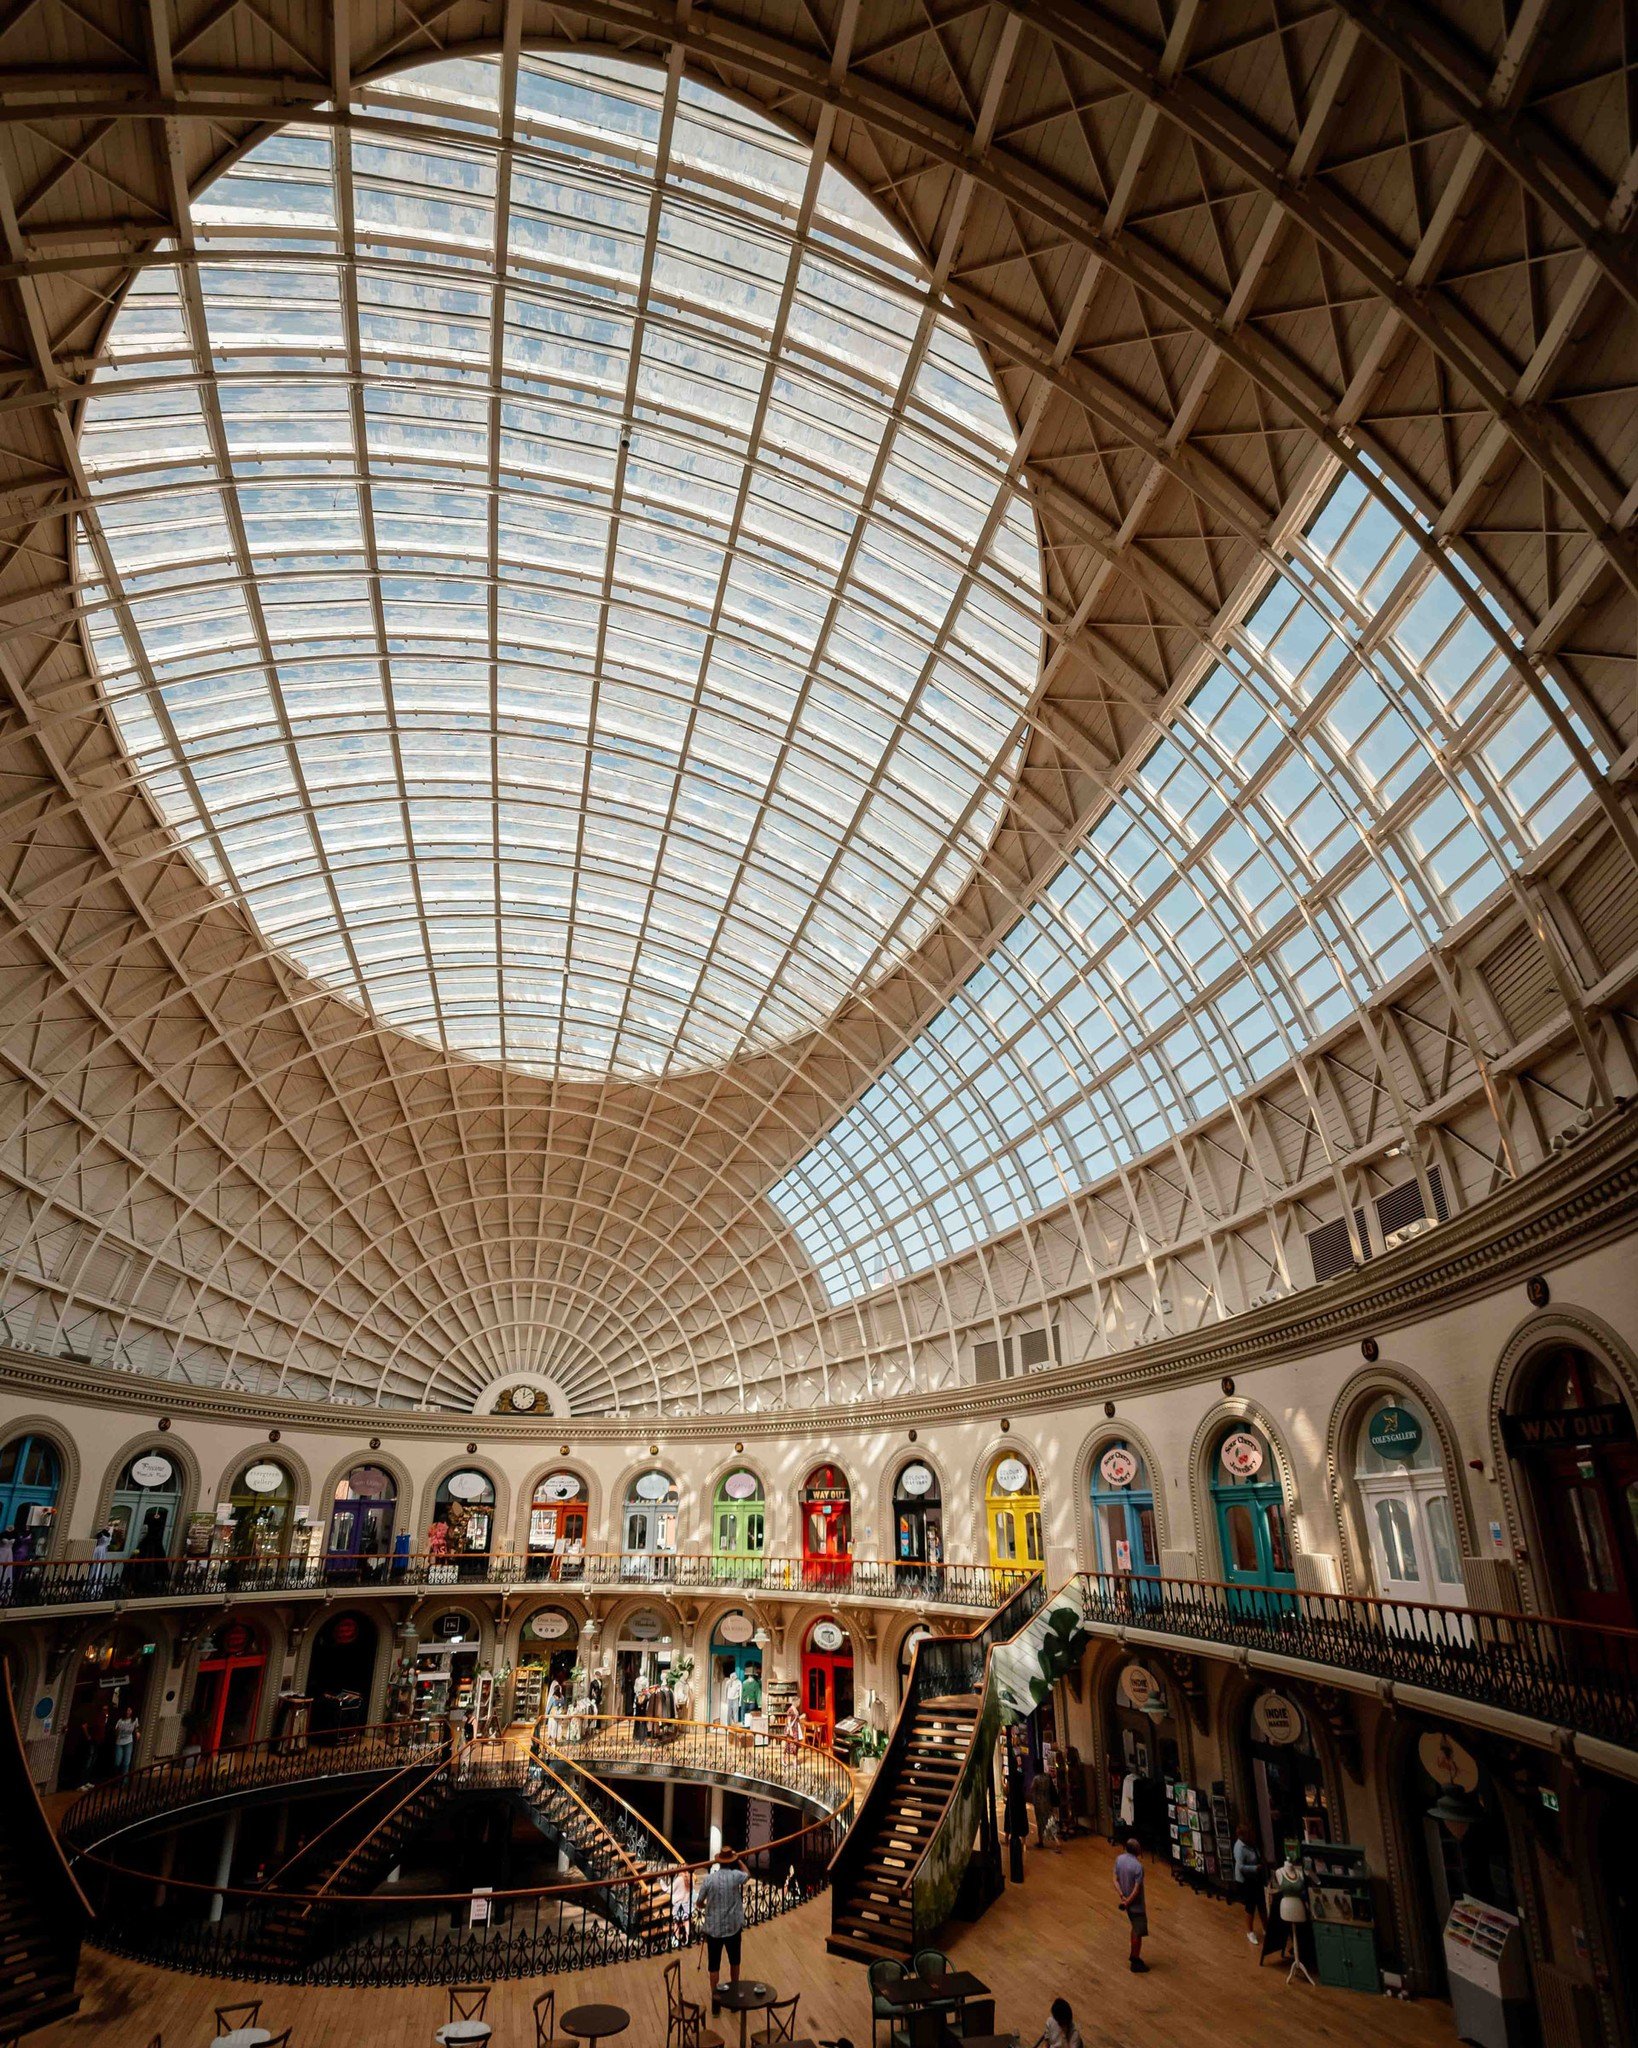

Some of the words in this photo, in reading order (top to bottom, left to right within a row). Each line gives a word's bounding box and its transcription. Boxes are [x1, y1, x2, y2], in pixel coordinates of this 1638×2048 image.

[1529, 1283, 1542, 1300] 12
[1364, 1342, 1373, 1355] 13
[1521, 1419, 1566, 1441] WAY
[1574, 1414, 1614, 1437] OUT
[1372, 1435, 1390, 1444] COLE'S
[1391, 1430, 1417, 1442] GALLERY
[1225, 1440, 1237, 1453] Sour
[1238, 1436, 1258, 1451] Cherry
[1115, 1452, 1131, 1465] Cherry
[1230, 1460, 1256, 1472] Jewellery
[253, 1478, 273, 1486] gallery
[1108, 1472, 1130, 1482] Jewellery
[813, 1491, 829, 1499] WAY
[831, 1491, 845, 1499] OUT
[1132, 1679, 1147, 1687] INDIE
[1266, 1709, 1287, 1718] INDIE
